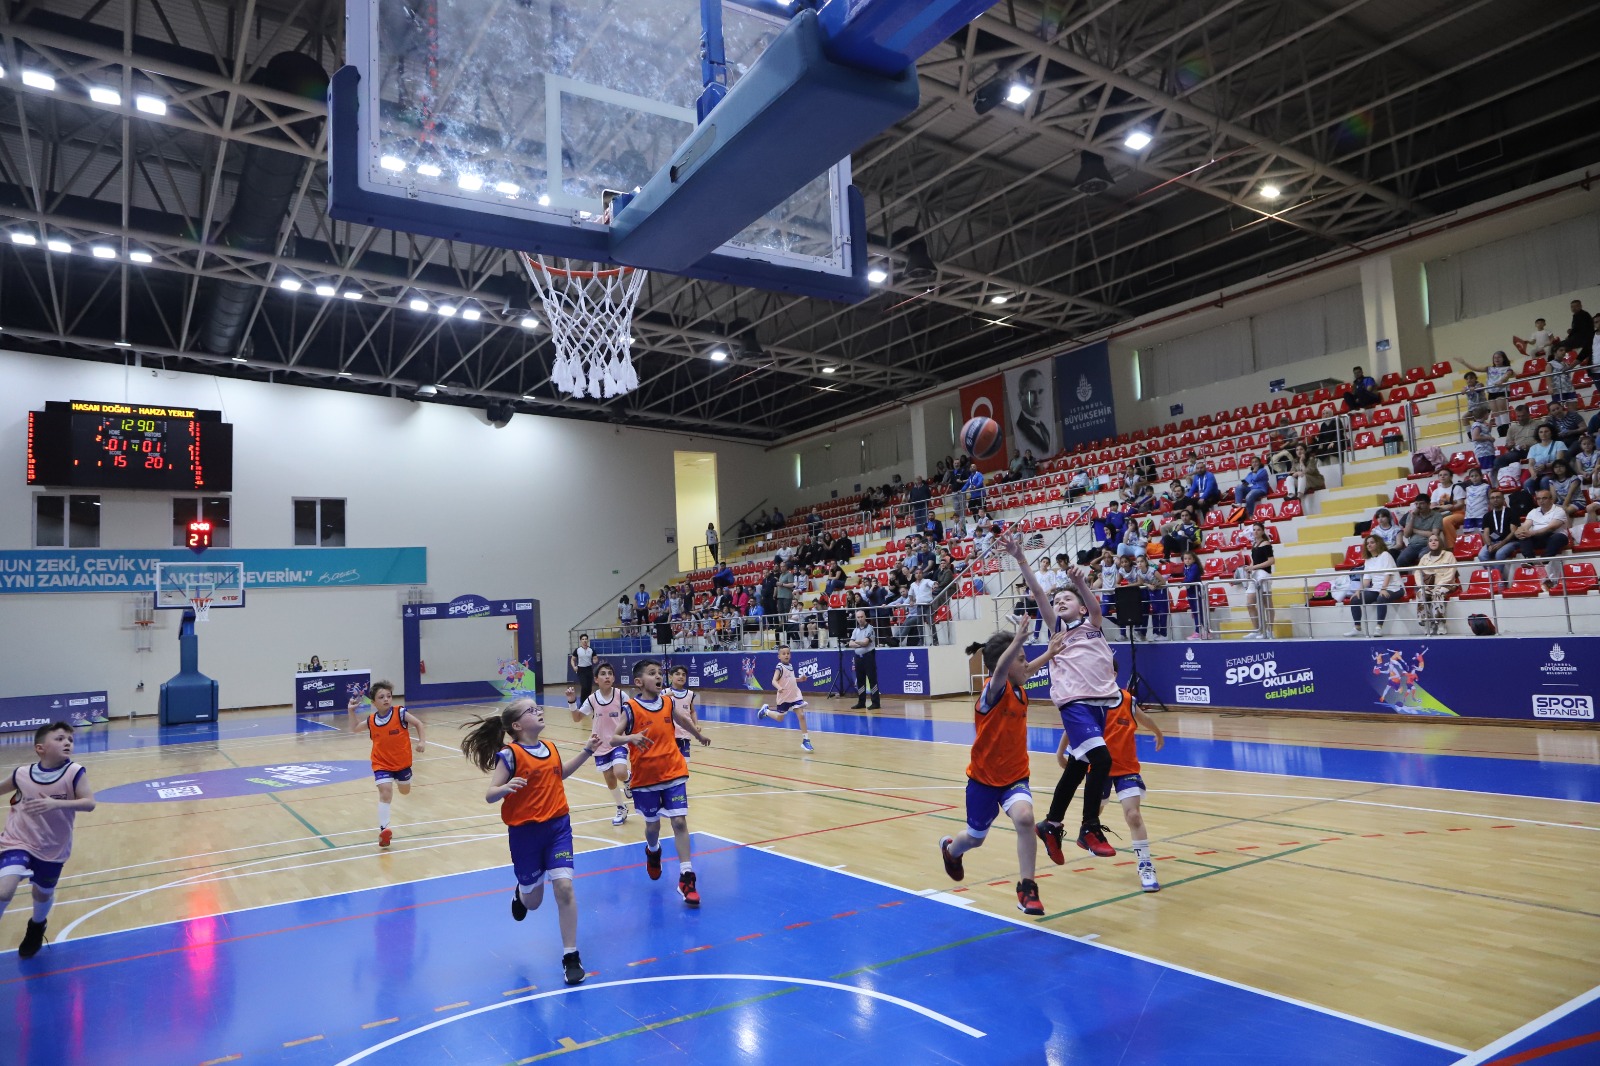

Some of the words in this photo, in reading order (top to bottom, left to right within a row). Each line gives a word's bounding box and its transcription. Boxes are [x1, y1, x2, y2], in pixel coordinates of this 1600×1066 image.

[72, 403, 100, 412] HASAN
[102, 404, 131, 413] DOĞAN
[138, 407, 167, 416] HAMZA
[1064, 406, 1112, 425] BÜYÜKŞEHİR
[121, 420, 134, 431] 12
[137, 420, 155, 432] 90
[131, 444, 139, 452] 4
[142, 440, 161, 453] 01
[113, 455, 127, 468] 15
[144, 456, 164, 469] 20
[189, 533, 208, 546] 21
[36, 555, 81, 573] ZEKİ,
[83, 555, 136, 573] ÇEVİK
[138, 558, 163, 572] VE
[37, 573, 128, 587] ZAMANDA
[449, 602, 474, 615] SPOR
[1226, 651, 1275, 668] İSTANBUL'UN
[798, 662, 818, 679] SPOR
[1225, 660, 1278, 685] SPOR
[1262, 671, 1314, 688] OKULLARI
[1177, 687, 1208, 696] SPOR
[1265, 685, 1298, 700] GELİŞİM
[1298, 682, 1315, 695] LİGİ
[1536, 696, 1589, 709] SPOR
[0, 717, 51, 728] ATLETİZM
